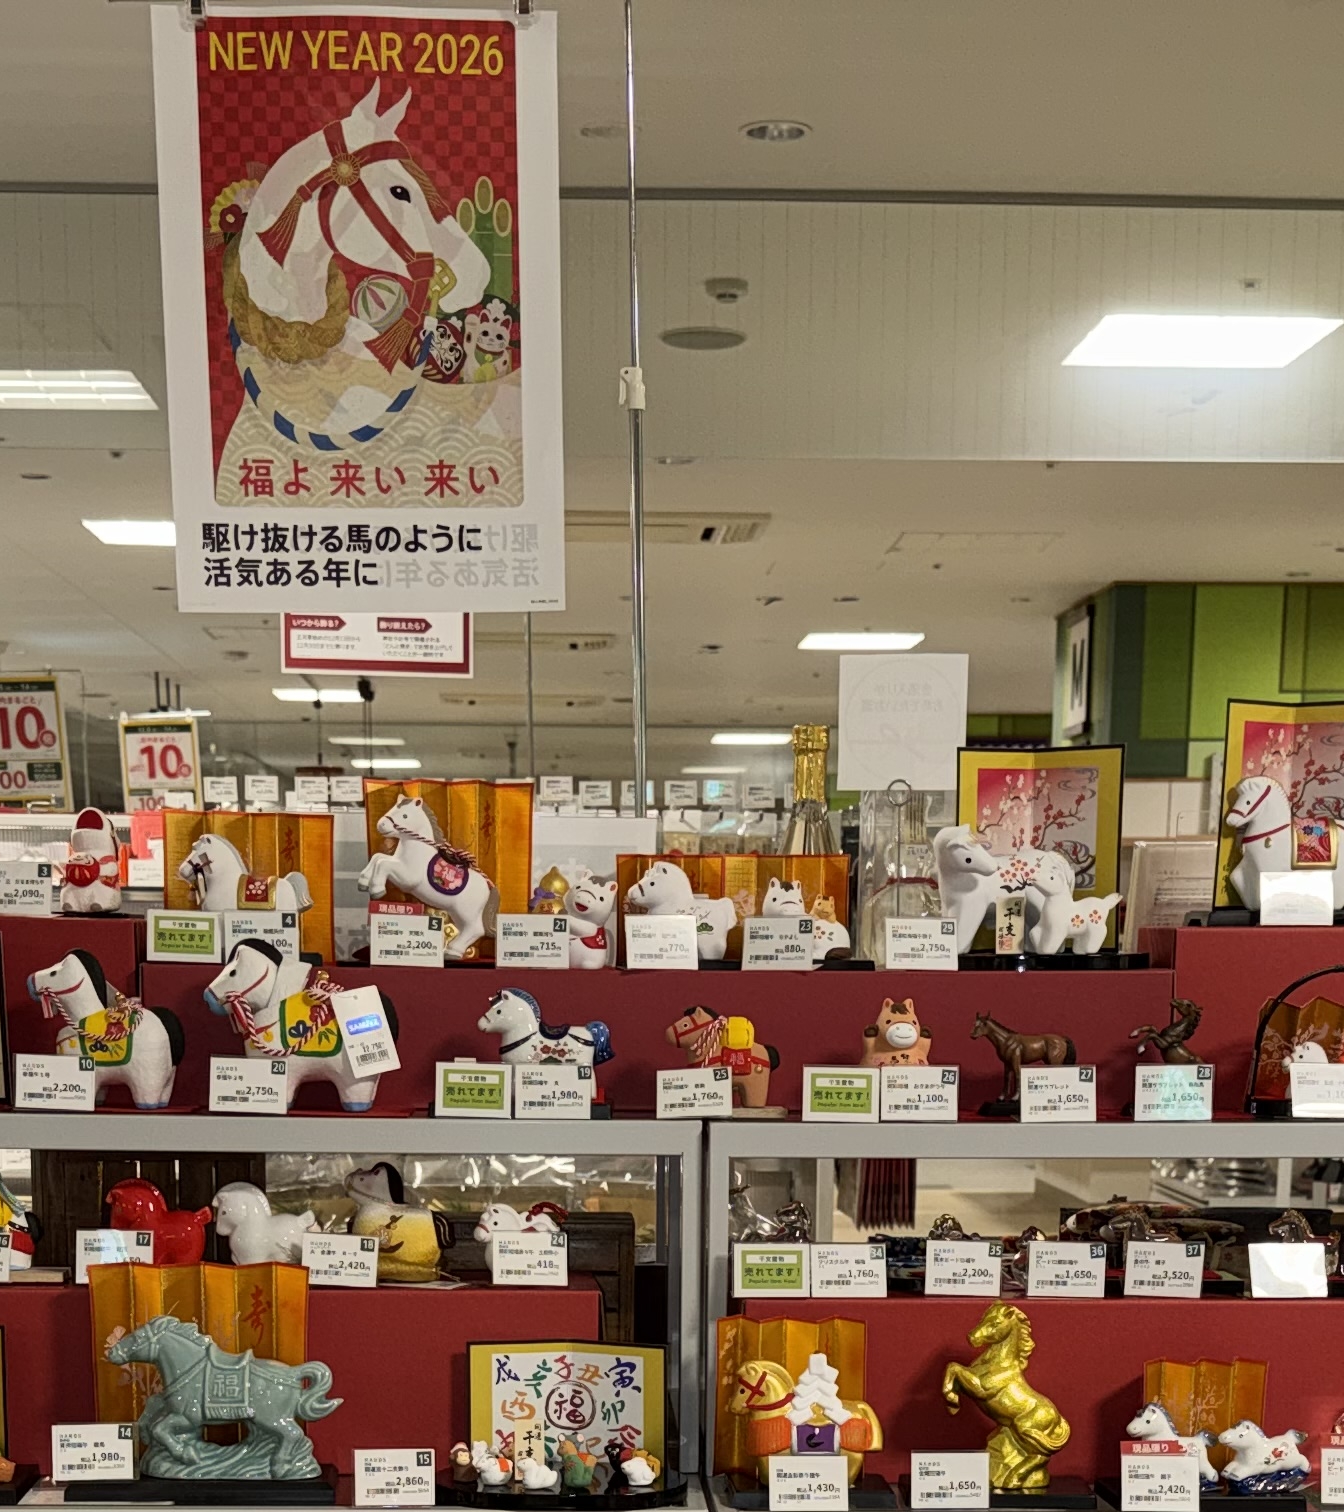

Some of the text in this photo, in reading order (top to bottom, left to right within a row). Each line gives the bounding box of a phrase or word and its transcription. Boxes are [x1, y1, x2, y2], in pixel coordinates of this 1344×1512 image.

[208, 31, 504, 77] NEW YEAR 2026
[201, 523, 483, 553] 駆け抜ける馬のように
[204, 557, 379, 588] 活気ある年に
